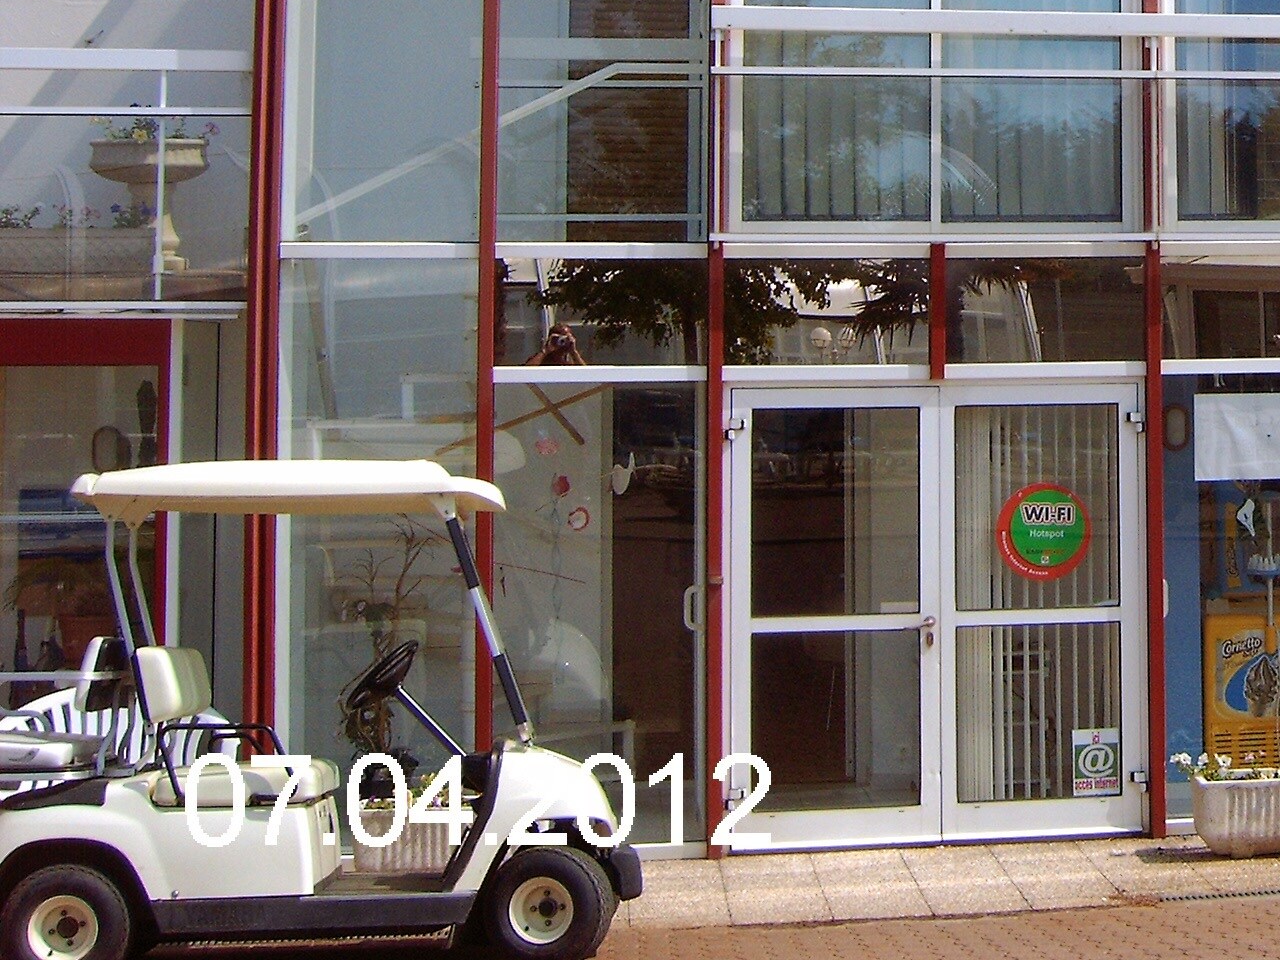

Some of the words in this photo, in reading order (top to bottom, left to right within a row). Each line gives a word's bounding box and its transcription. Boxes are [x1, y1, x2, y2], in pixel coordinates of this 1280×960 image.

[1022, 504, 1073, 522] WI-FI
[1029, 529, 1065, 540] Hotspot
[1222, 637, 1262, 658] Cornetto
